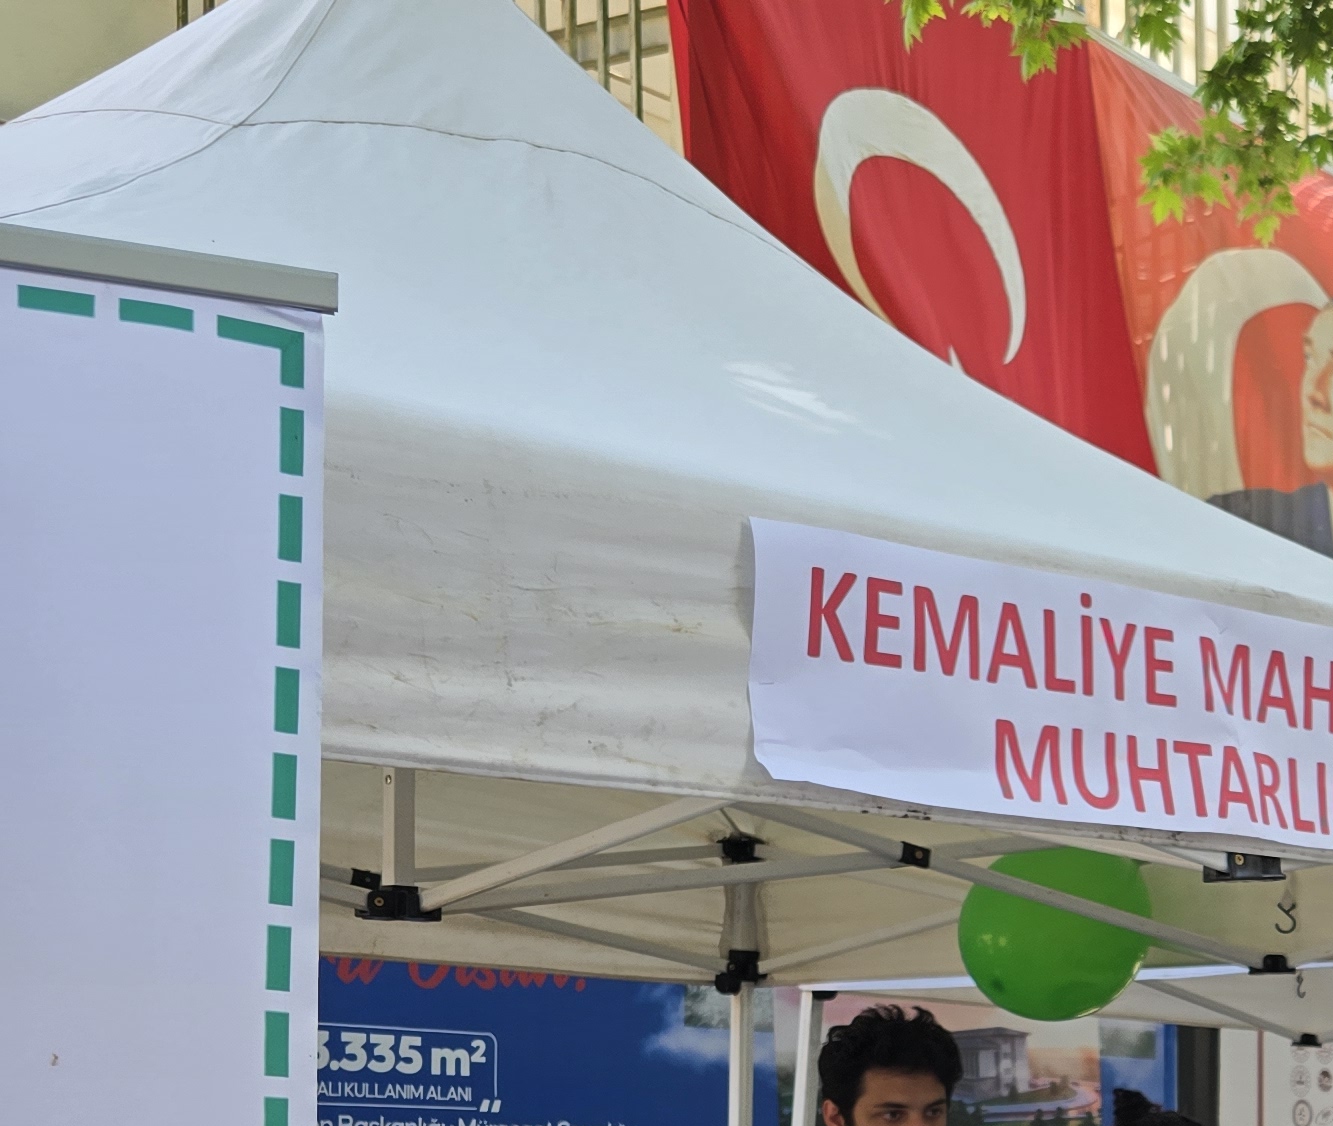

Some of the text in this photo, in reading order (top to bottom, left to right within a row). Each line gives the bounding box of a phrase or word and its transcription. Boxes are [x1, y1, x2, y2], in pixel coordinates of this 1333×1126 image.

[806, 565, 1178, 708] KEMALİYE
[317, 1082, 472, 1102] ALI KULLANIM ALANI
